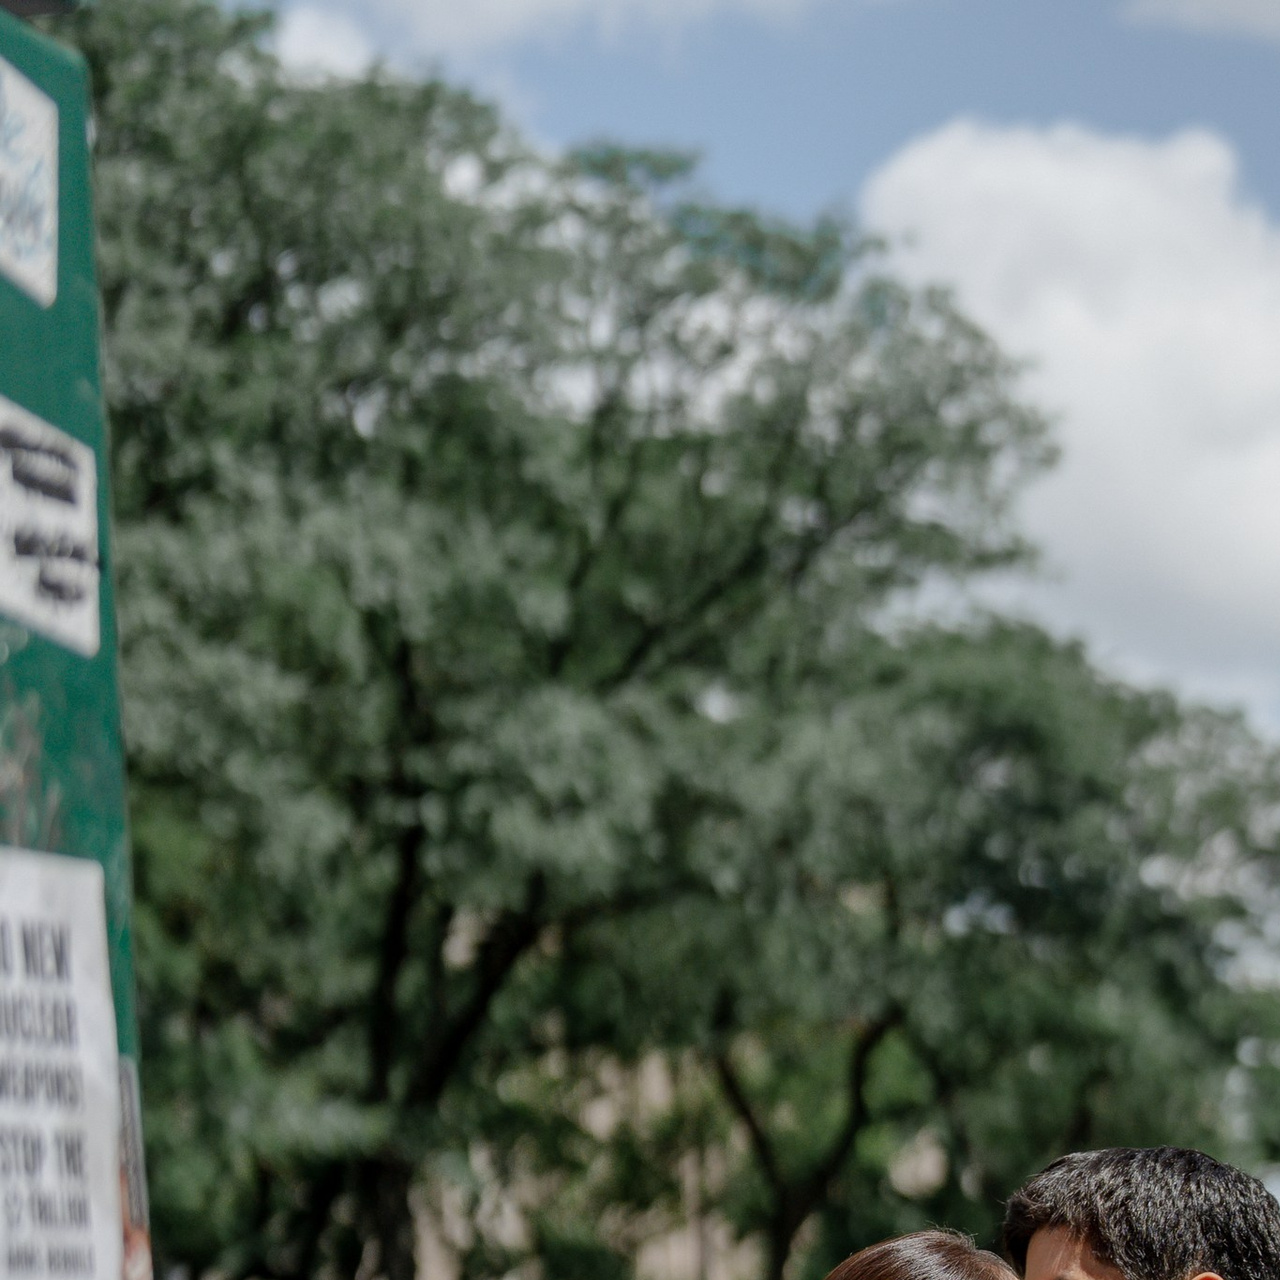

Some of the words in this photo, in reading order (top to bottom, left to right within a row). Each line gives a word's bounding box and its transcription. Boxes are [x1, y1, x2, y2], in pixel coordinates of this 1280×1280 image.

[22, 921, 72, 982] NEW
[0, 997, 79, 1051] UCLEAR
[0, 1127, 46, 1179] STOP
[54, 1130, 88, 1182] THE
